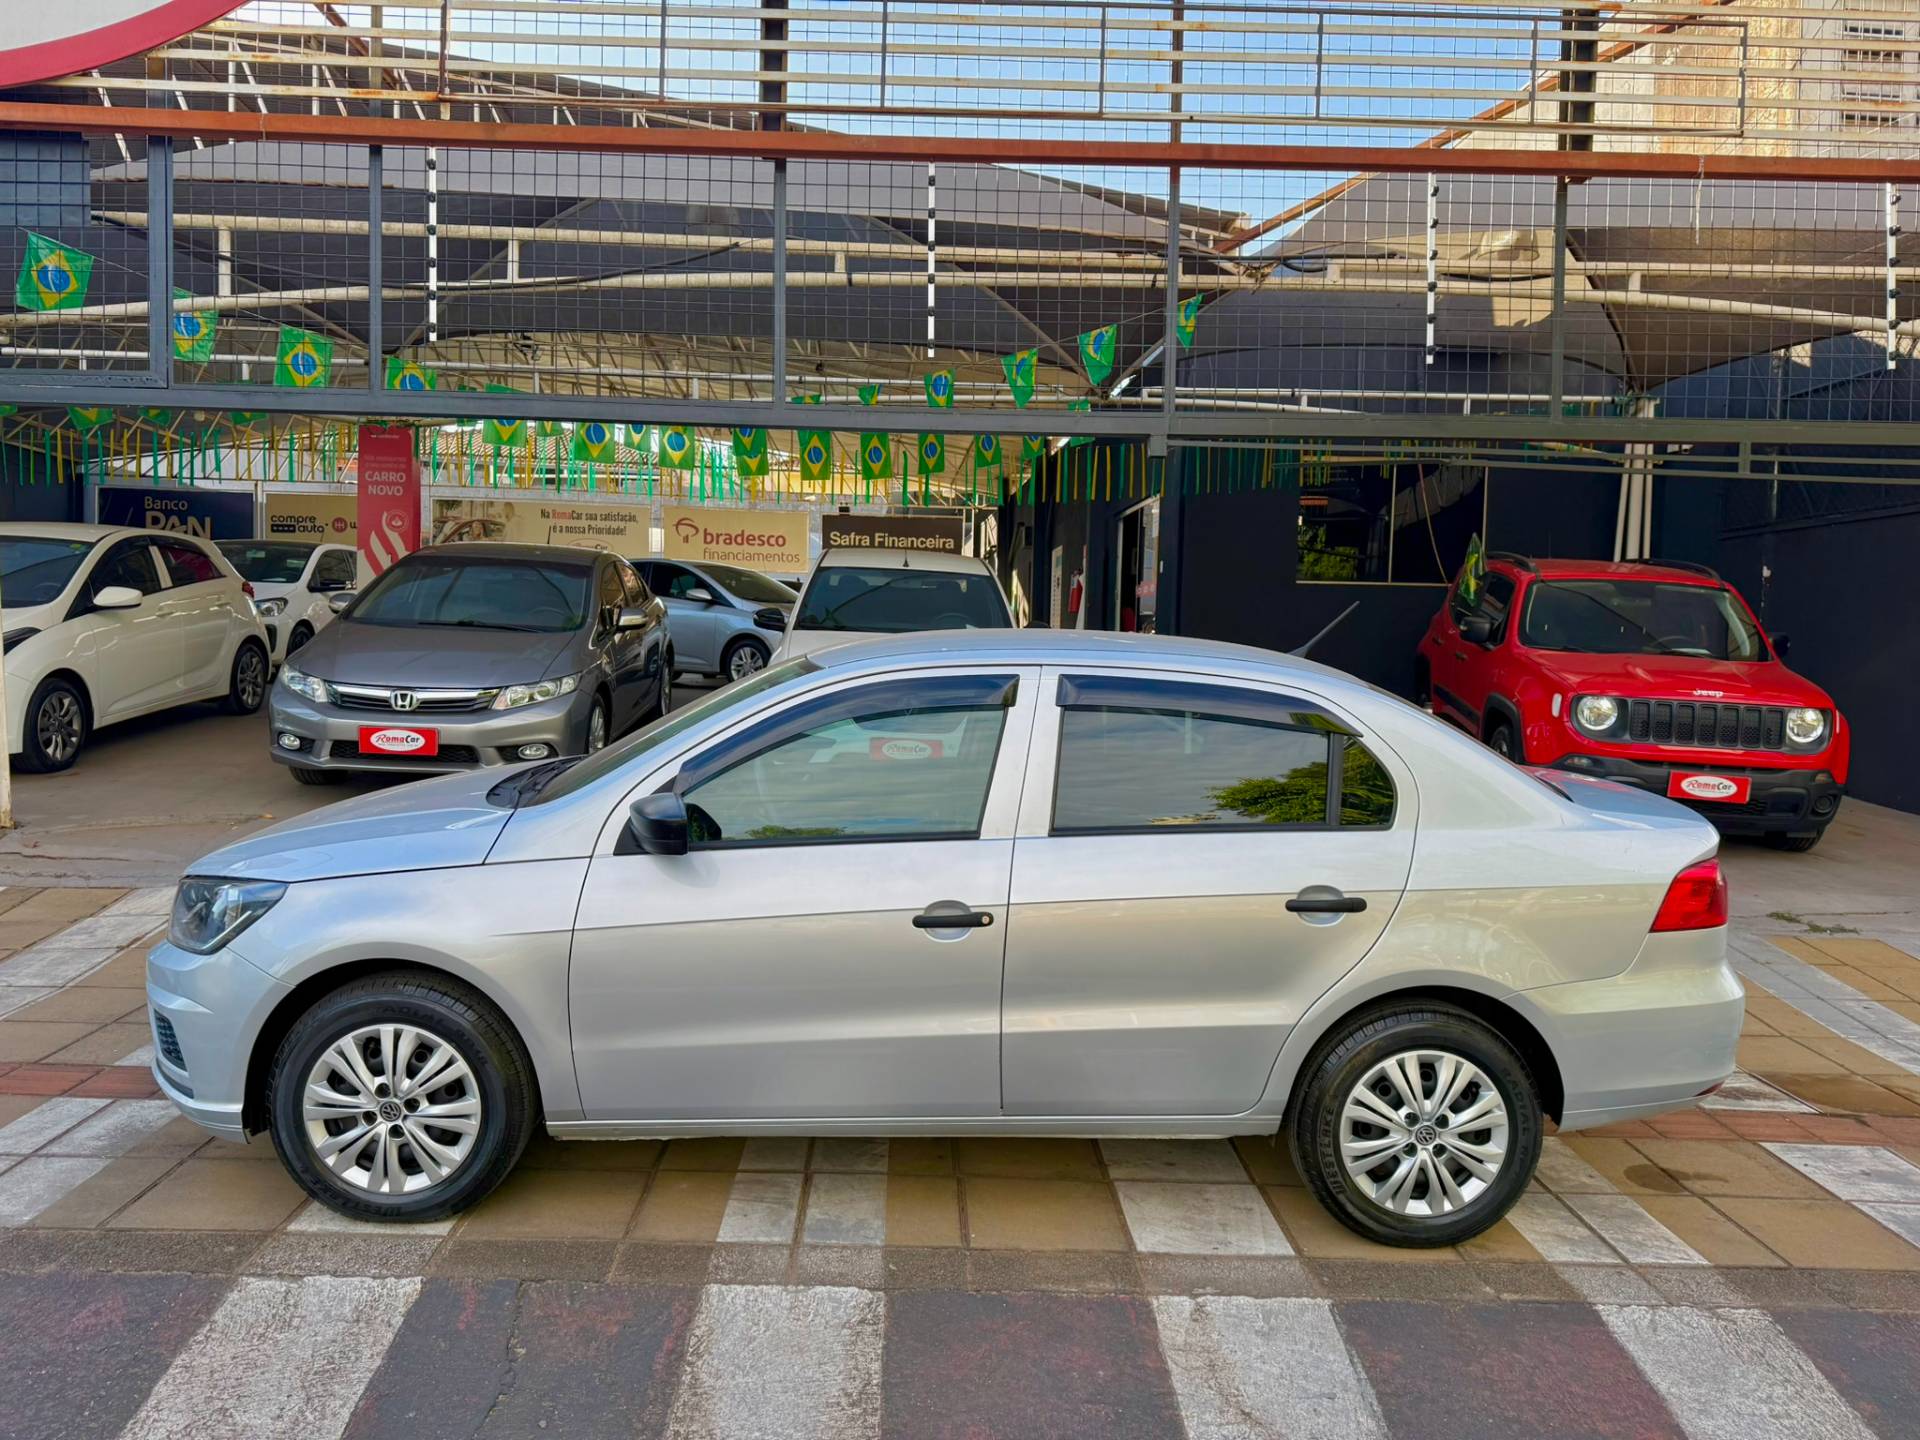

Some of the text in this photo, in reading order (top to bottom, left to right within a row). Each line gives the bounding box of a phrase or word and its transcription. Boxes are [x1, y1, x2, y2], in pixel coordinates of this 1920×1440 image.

[365, 471, 406, 483] CARRO
[368, 484, 404, 496] NOVO
[144, 496, 188, 510] Banco
[270, 514, 317, 525] compre
[540, 508, 638, 524] Na RomaCar sua satisfação,
[145, 511, 212, 540] PAN
[297, 523, 325, 533] auto
[552, 523, 626, 536] é a nossa Prioridade!
[703, 528, 786, 547] bradesco
[829, 531, 955, 549] Safra Financeira
[703, 547, 800, 563] financiamentos
[1693, 688, 1724, 698] Jeep
[375, 734, 420, 743] RomaCar
[1687, 780, 1732, 790] RomaCar
[1319, 1105, 1347, 1197] WESTLAKE
